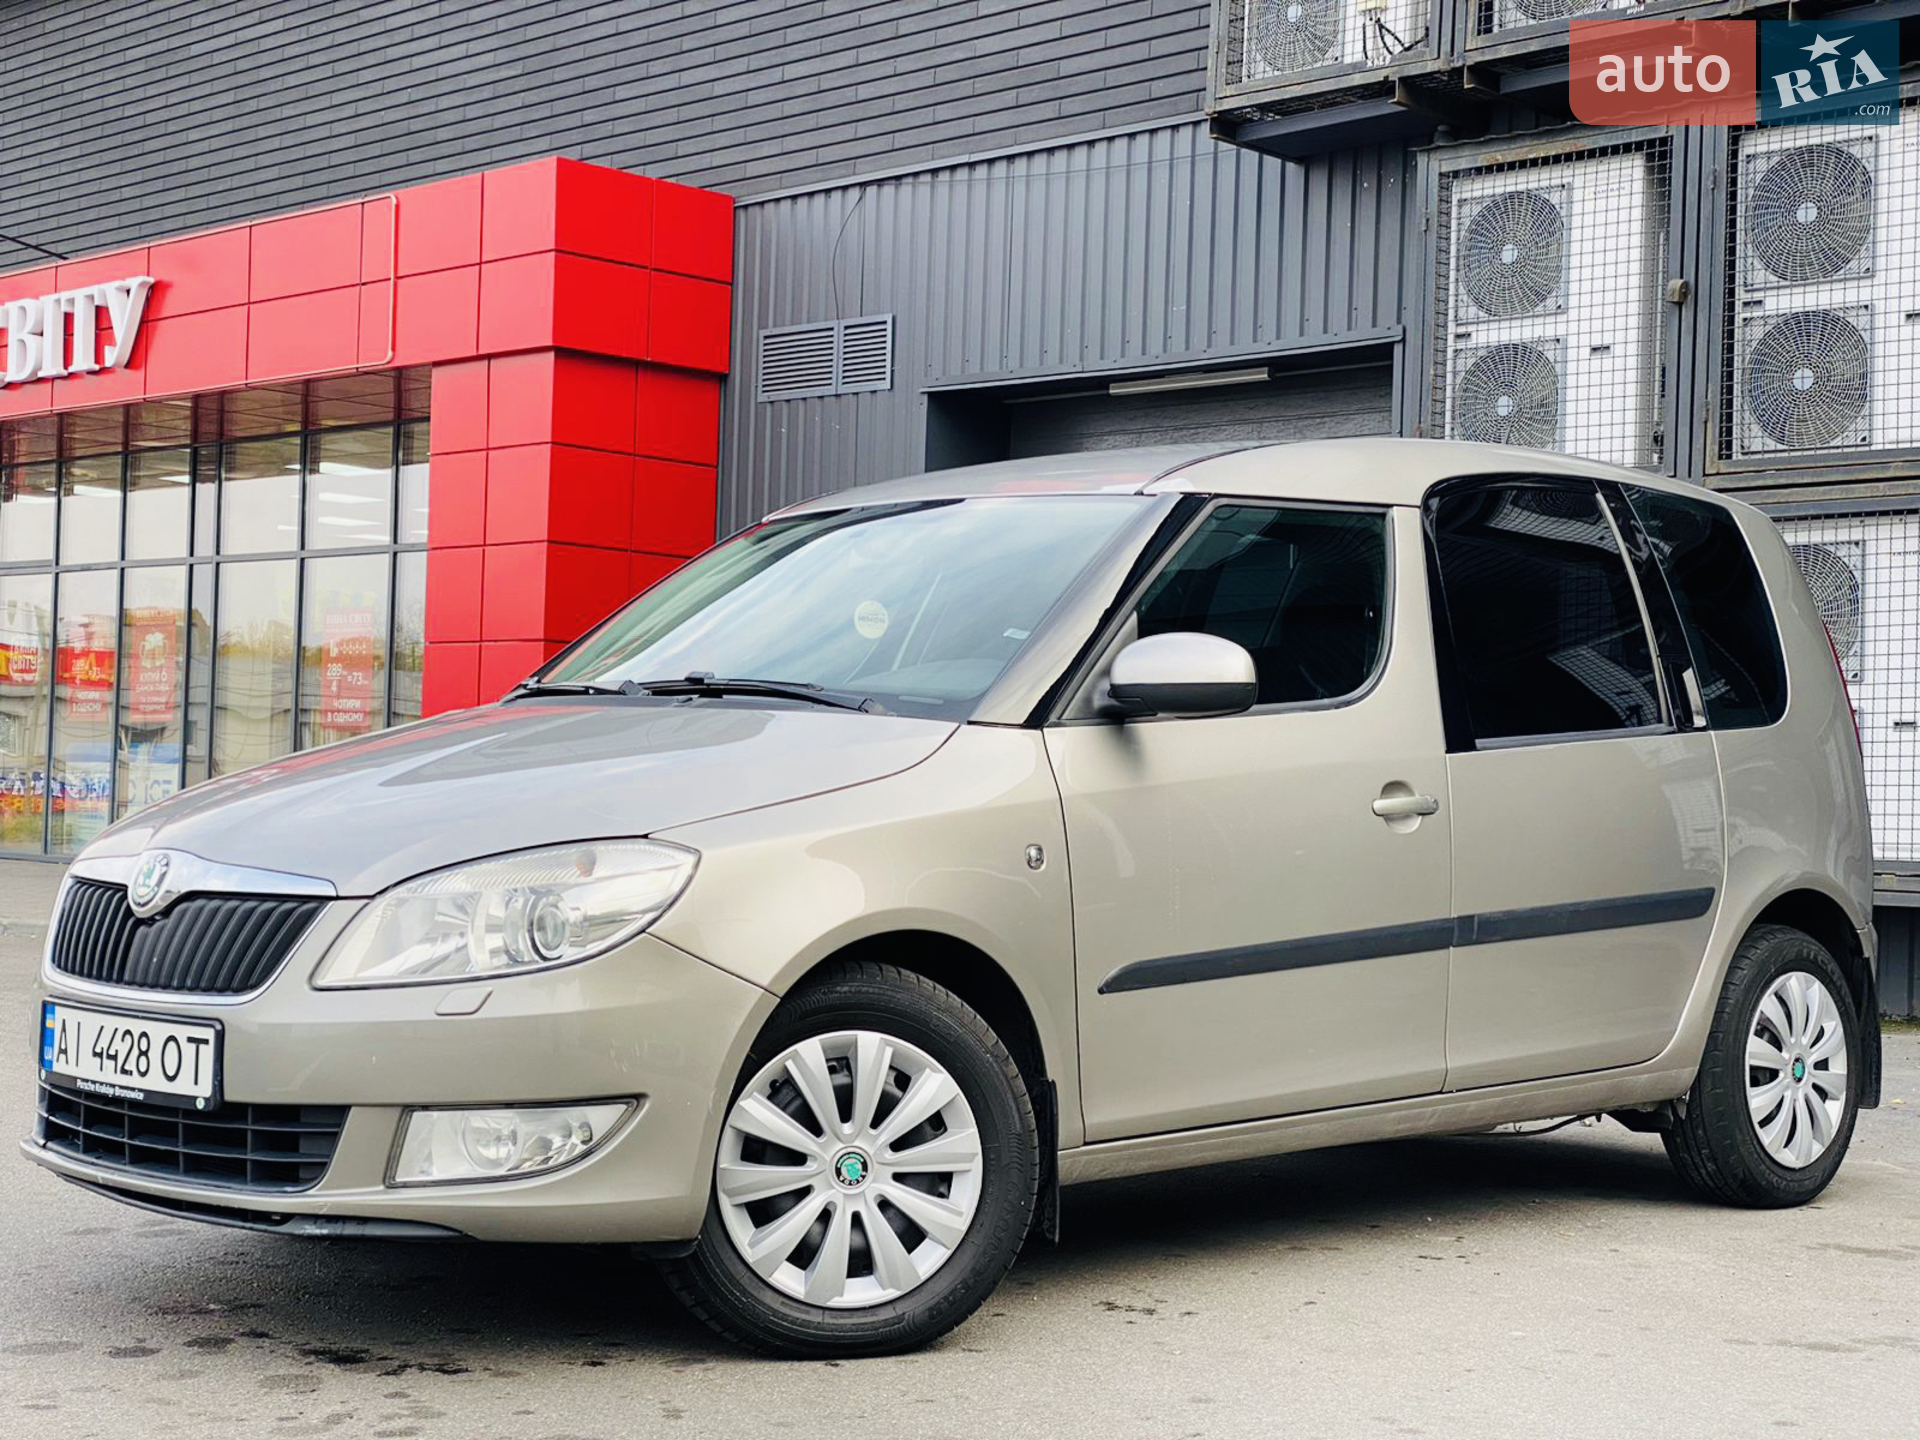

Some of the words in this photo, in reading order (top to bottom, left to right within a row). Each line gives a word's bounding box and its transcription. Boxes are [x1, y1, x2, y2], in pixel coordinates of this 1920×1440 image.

[326, 663, 342, 676] 289
[330, 680, 337, 692] 4
[333, 699, 363, 709] ЧОТИРИ
[333, 712, 365, 722] ОДНОМУ
[56, 1018, 81, 1067] AI
[92, 1025, 151, 1078] 4428
[161, 1034, 209, 1086] OT
